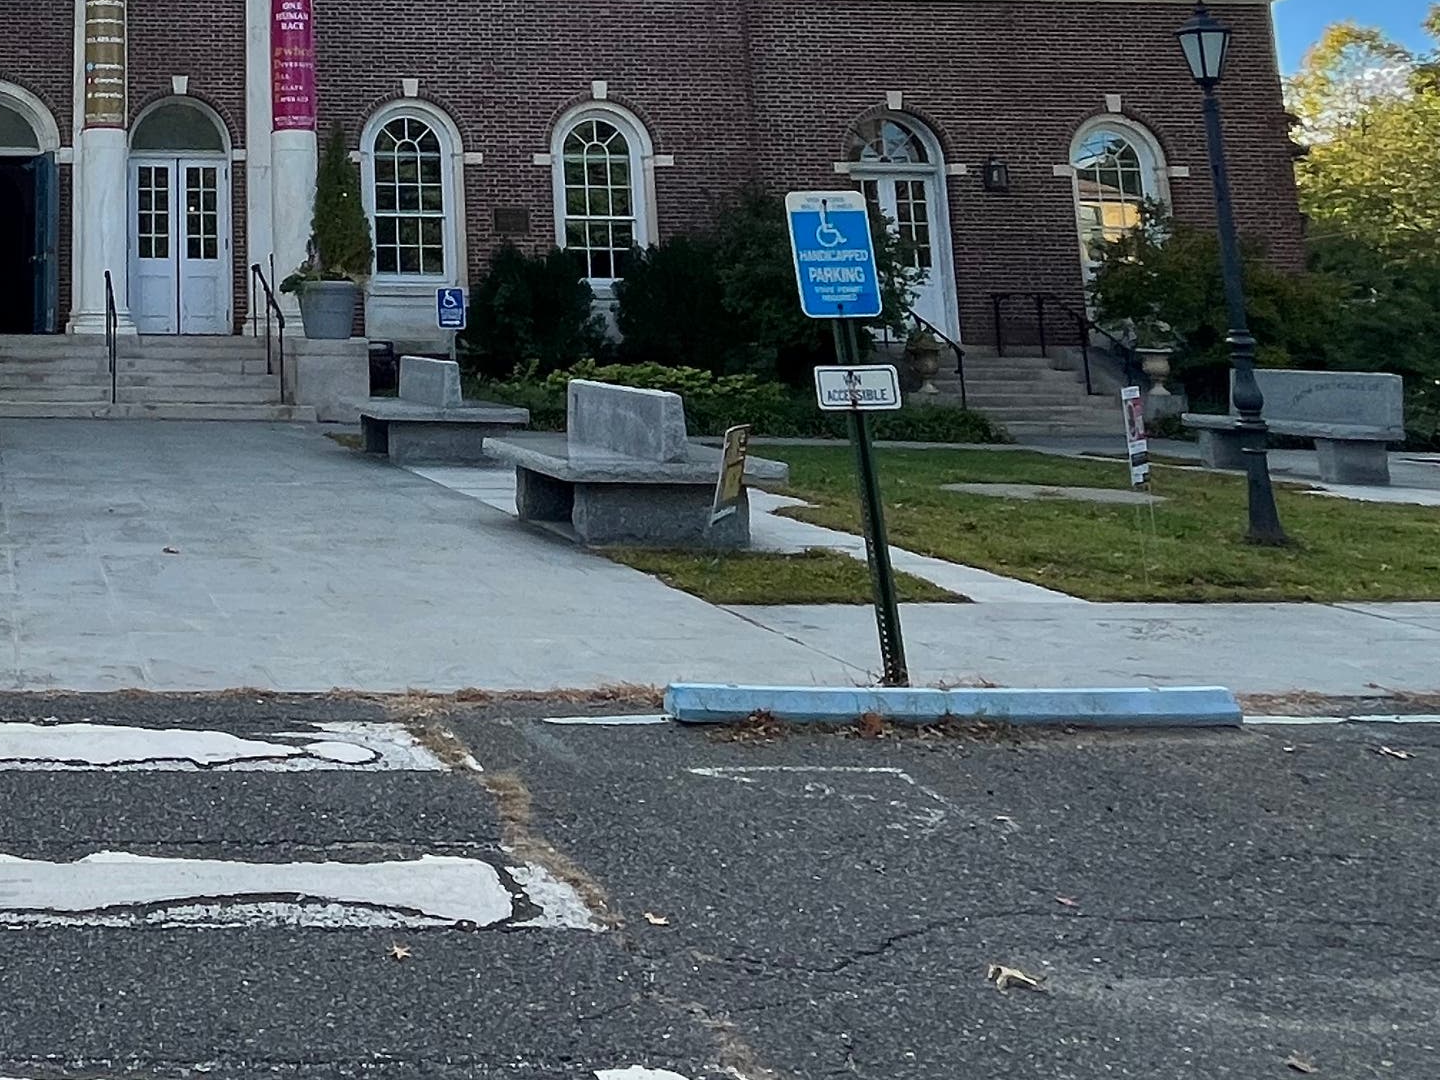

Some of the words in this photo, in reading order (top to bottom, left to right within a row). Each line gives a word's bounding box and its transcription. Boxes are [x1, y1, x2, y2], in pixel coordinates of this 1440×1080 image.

[282, 2, 303, 10] ONE
[275, 11, 309, 21] HUMAN
[280, 21, 304, 30] RACE
[799, 249, 869, 262] HANDICAPPED
[808, 267, 866, 283] PARKING
[827, 387, 889, 402] ACCESSIBLE
